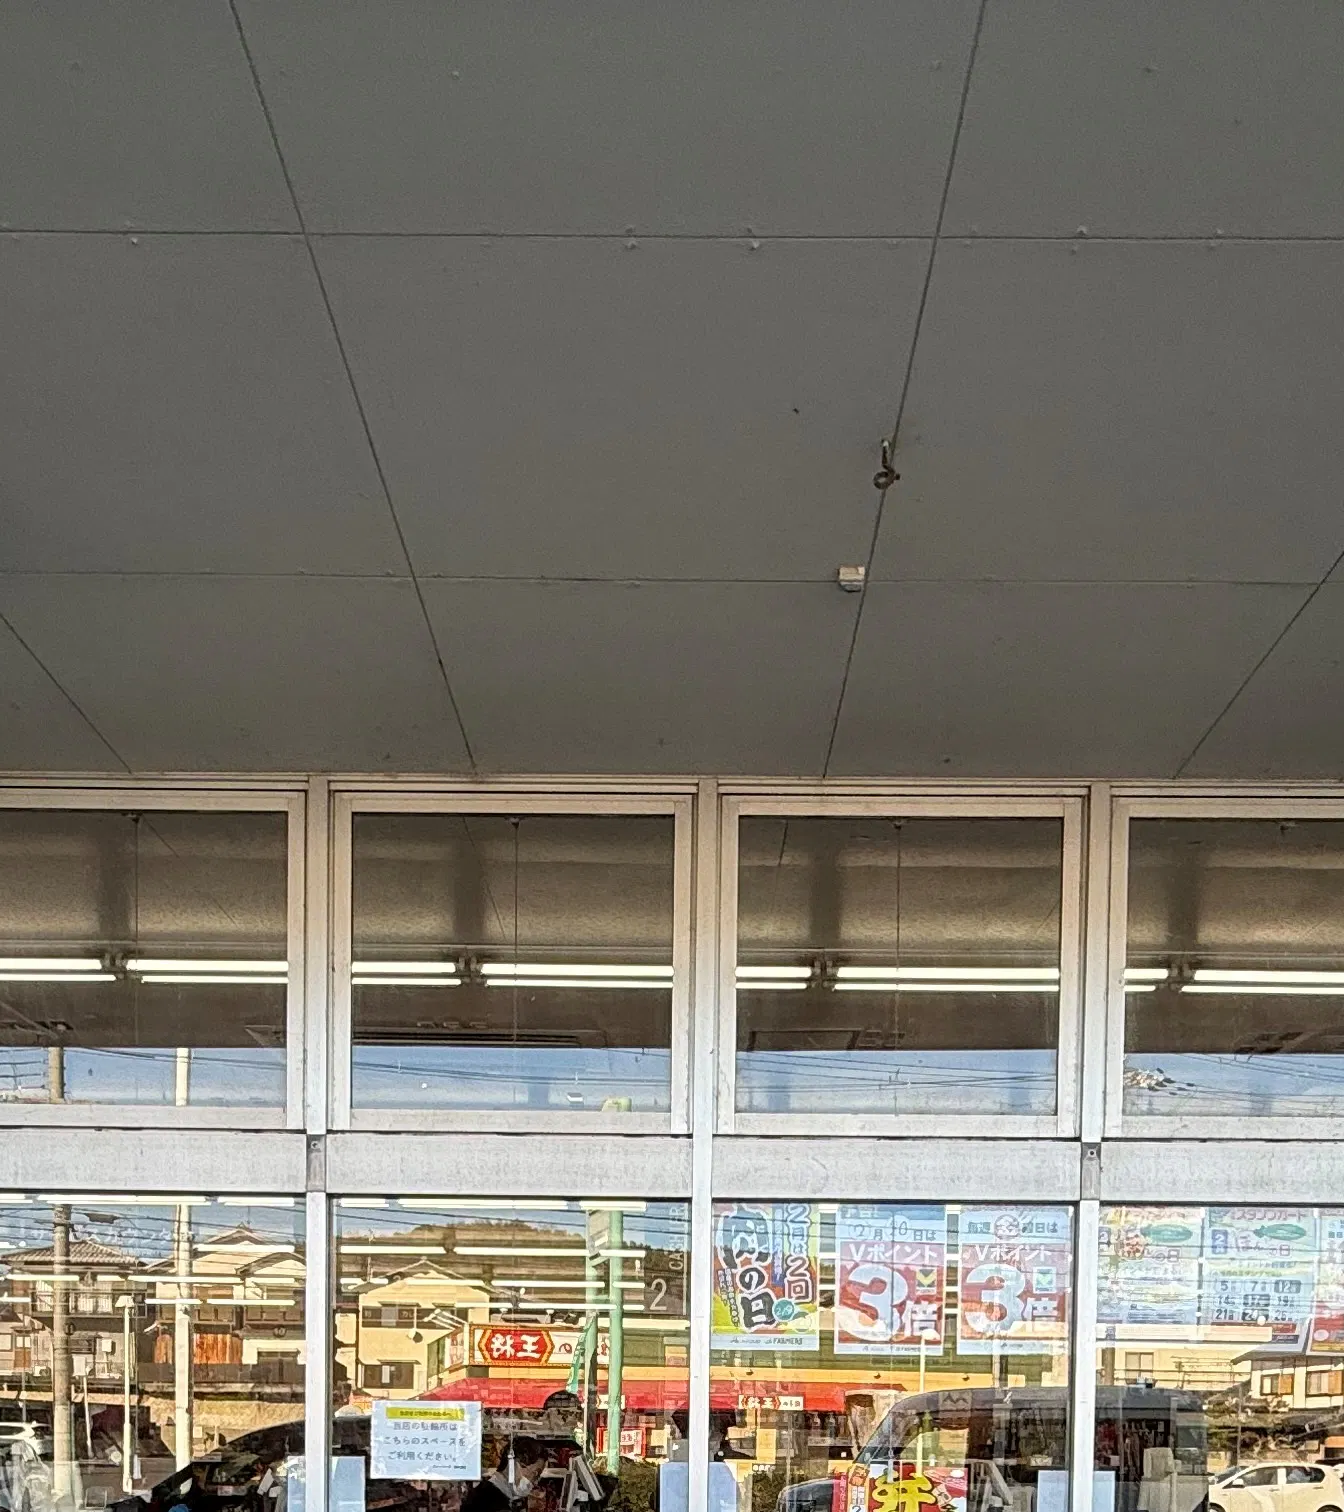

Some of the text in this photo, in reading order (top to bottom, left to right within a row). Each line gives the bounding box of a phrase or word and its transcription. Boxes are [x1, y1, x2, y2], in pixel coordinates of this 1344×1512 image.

[849, 1243, 939, 1265] Vポイント
[649, 1278, 668, 1310] 2
